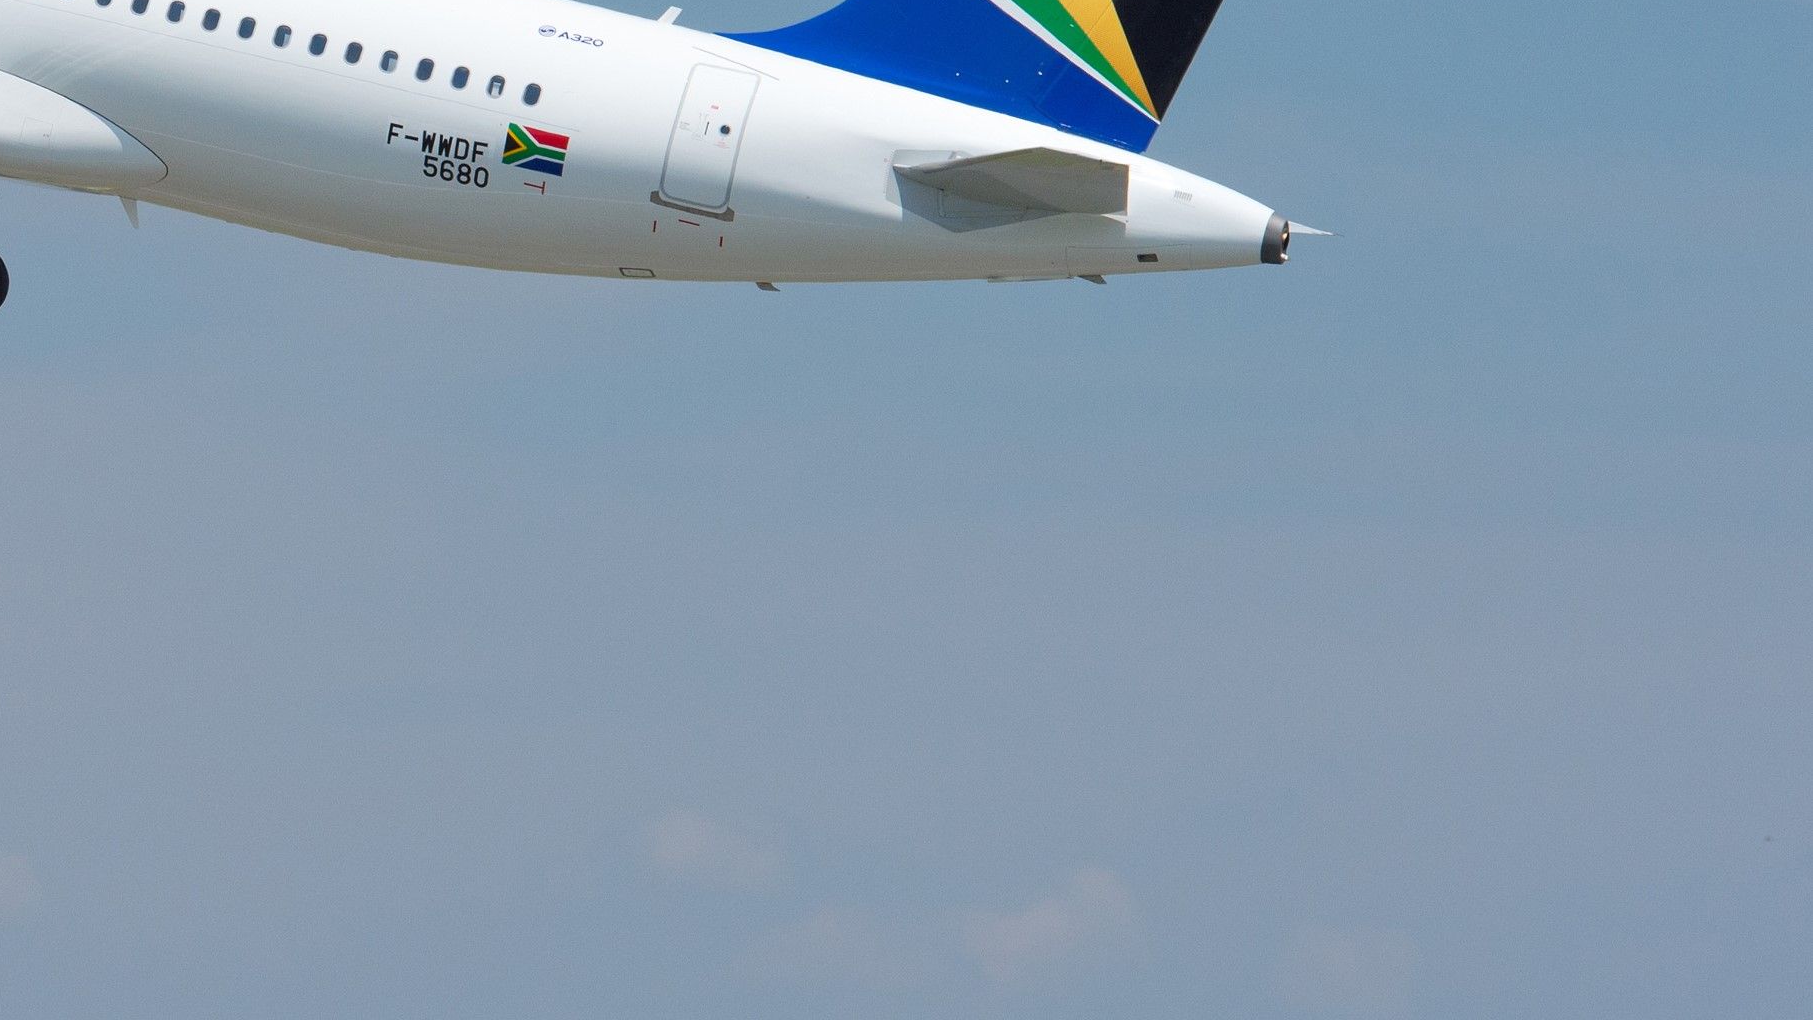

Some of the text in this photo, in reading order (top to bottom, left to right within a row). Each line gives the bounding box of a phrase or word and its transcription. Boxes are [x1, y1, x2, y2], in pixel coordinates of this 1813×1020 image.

[558, 31, 604, 47] A320
[387, 122, 489, 163] F-WWDF
[423, 155, 490, 188] 5680
